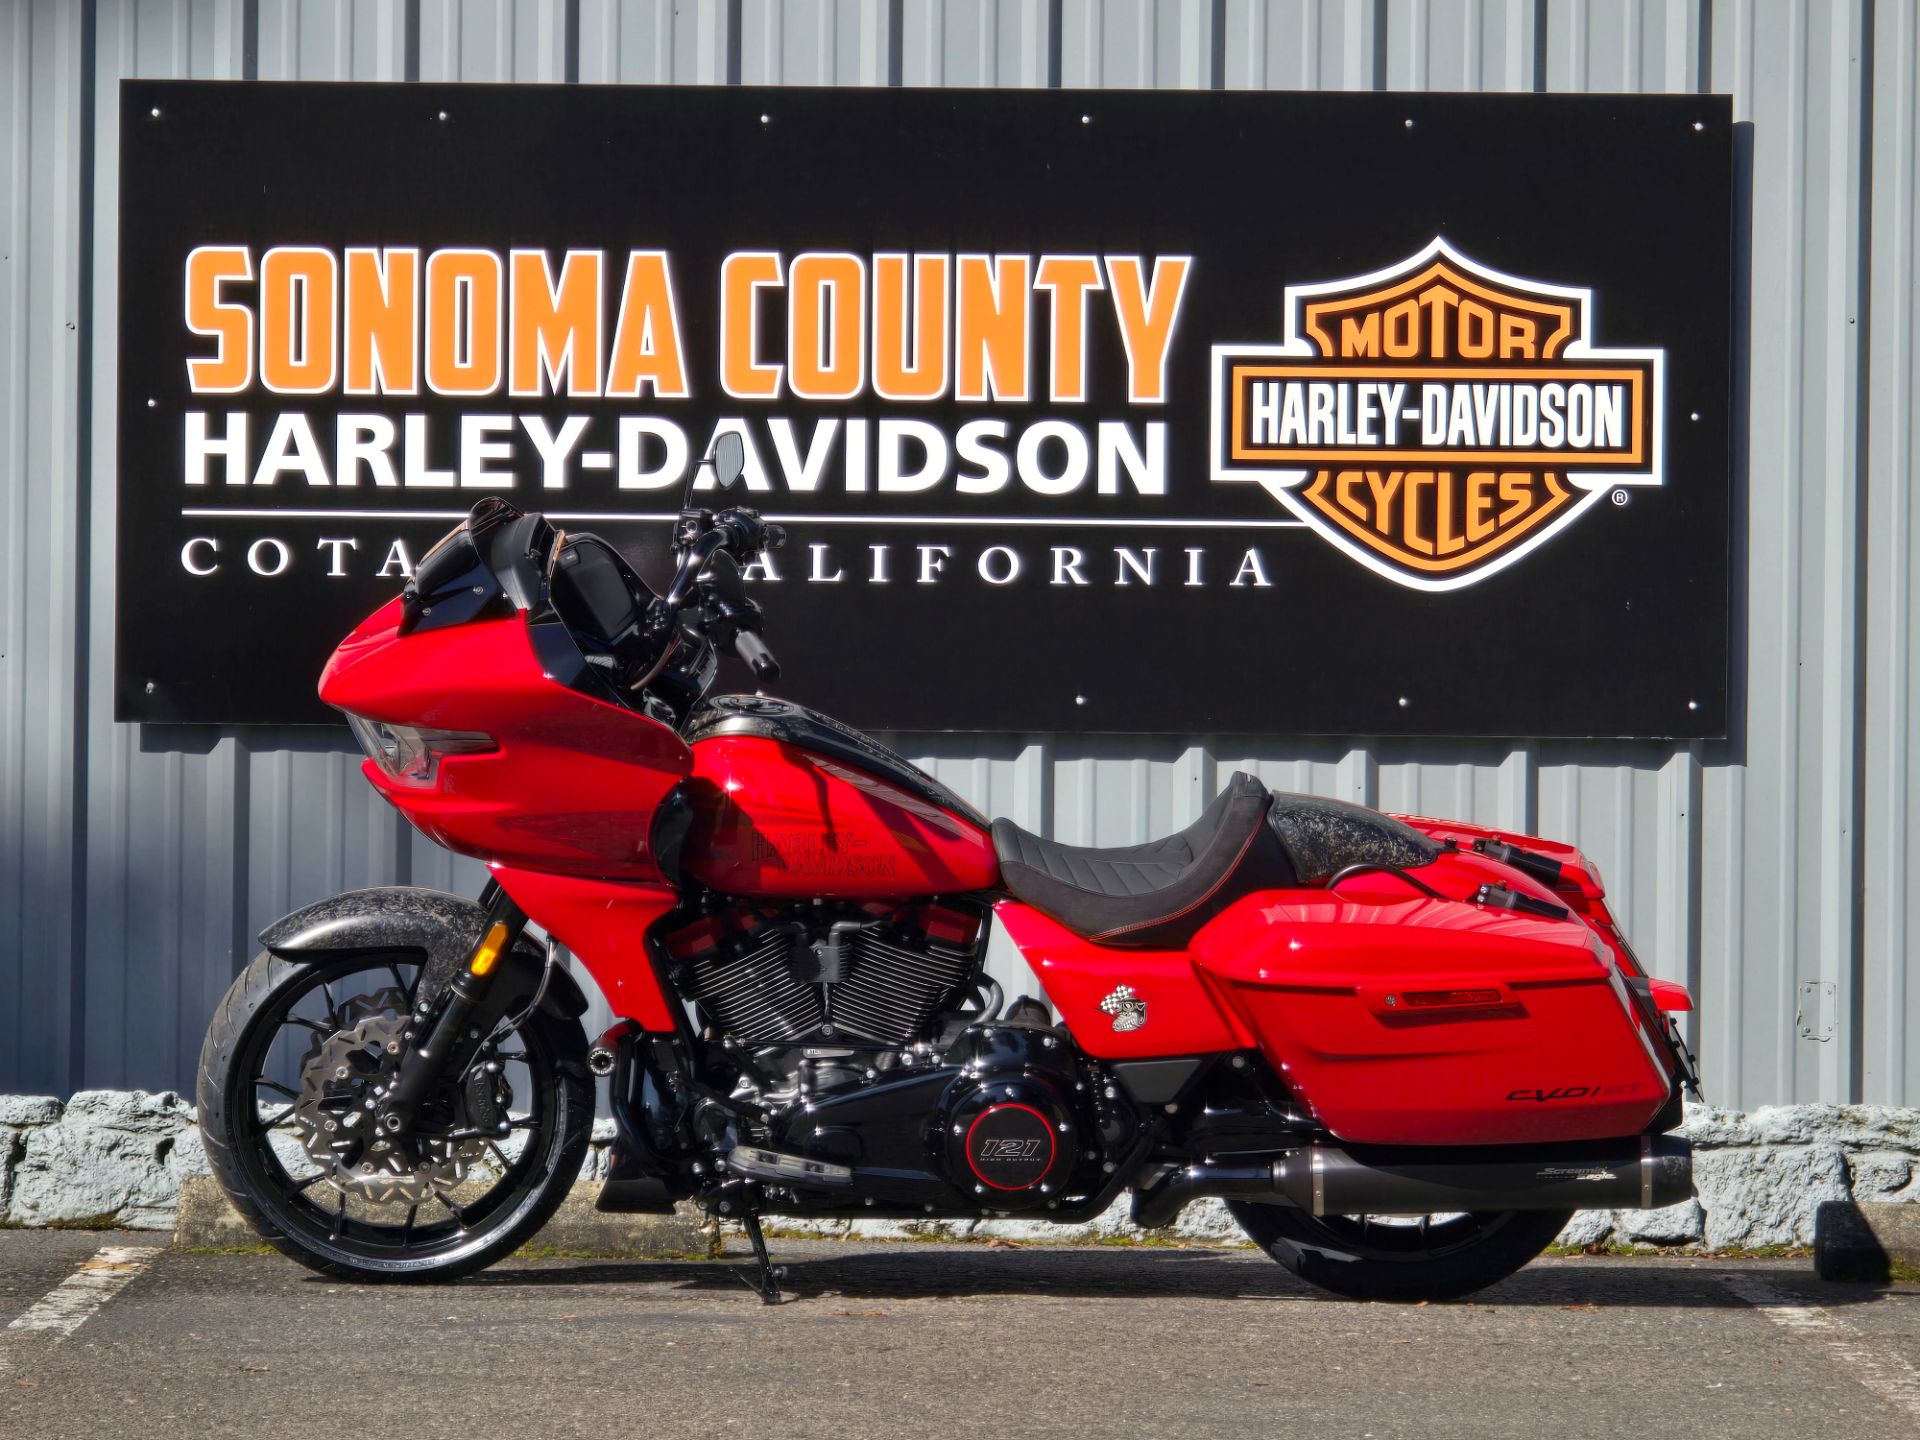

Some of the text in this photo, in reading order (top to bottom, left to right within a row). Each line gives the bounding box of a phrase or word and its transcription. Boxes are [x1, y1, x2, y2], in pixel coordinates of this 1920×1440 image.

[185, 245, 1194, 404] SONOMA COUNTY
[1341, 284, 1536, 359] MOTOR
[1252, 382, 1623, 448] HARLEY-DAVIDSON
[184, 412, 1166, 495] HARLEY-DAVIDSON
[1336, 471, 1533, 556] CYCLES
[180, 538, 1272, 587] COTA ALIFORNIA
[781, 855, 896, 877] DAVIDSON
[980, 1139, 1041, 1157] 121
